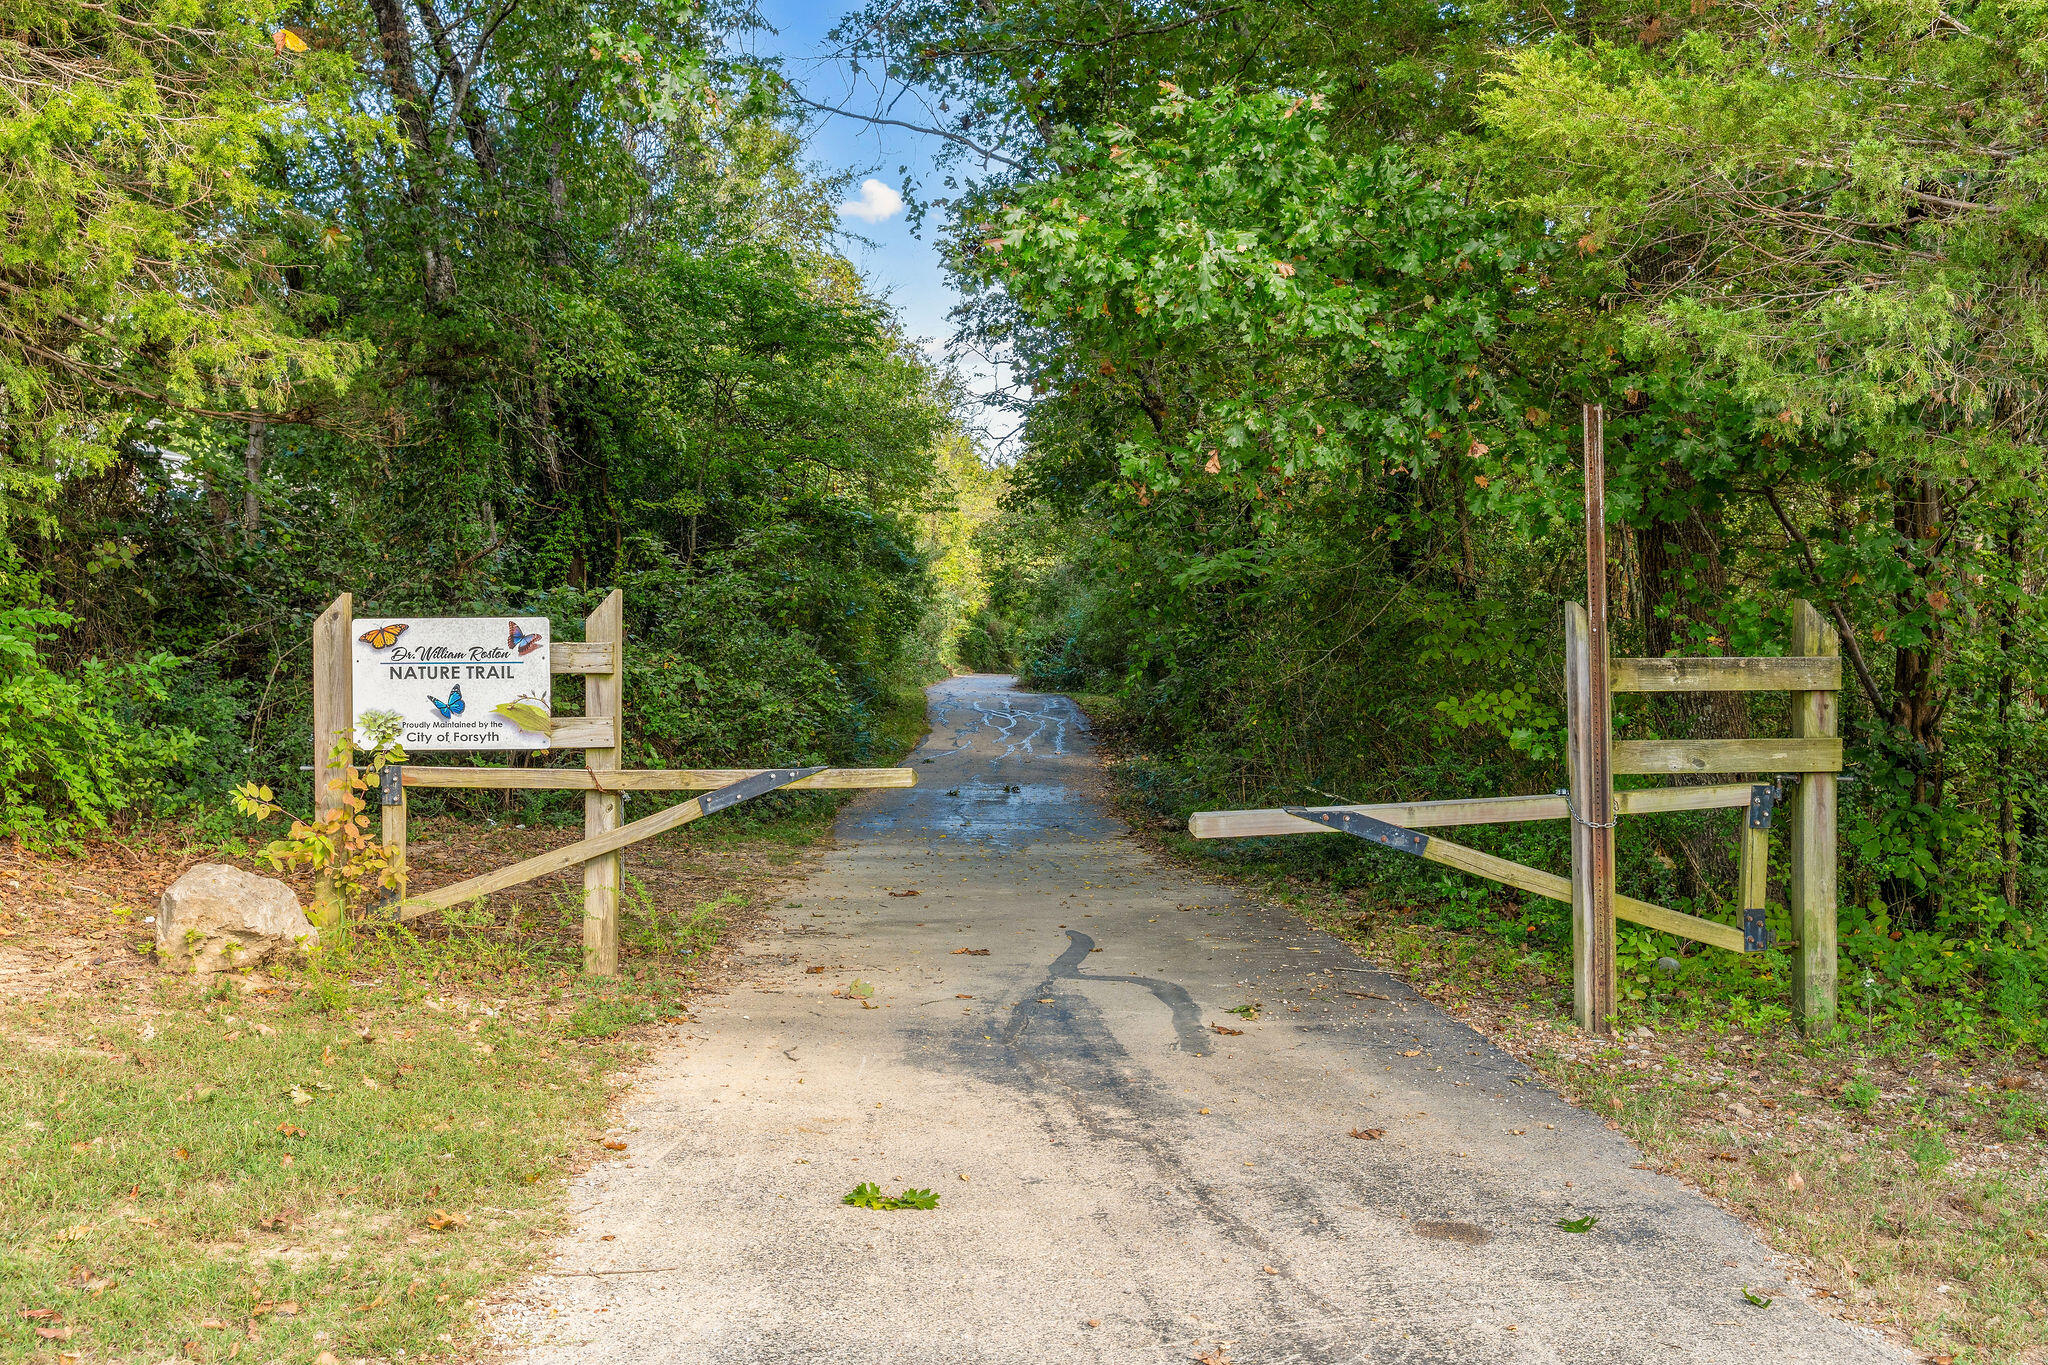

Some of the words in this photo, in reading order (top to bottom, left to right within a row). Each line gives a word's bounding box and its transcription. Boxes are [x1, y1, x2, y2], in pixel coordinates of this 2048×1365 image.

[391, 647, 416, 662] Dr.
[416, 646, 467, 662] William
[389, 666, 460, 680] NATURE
[466, 665, 515, 680] TRAIL
[402, 721, 431, 729] Proudly
[478, 721, 489, 729] by
[406, 732, 433, 744] City
[436, 732, 450, 742] of
[453, 732, 500, 744] Forsyth
